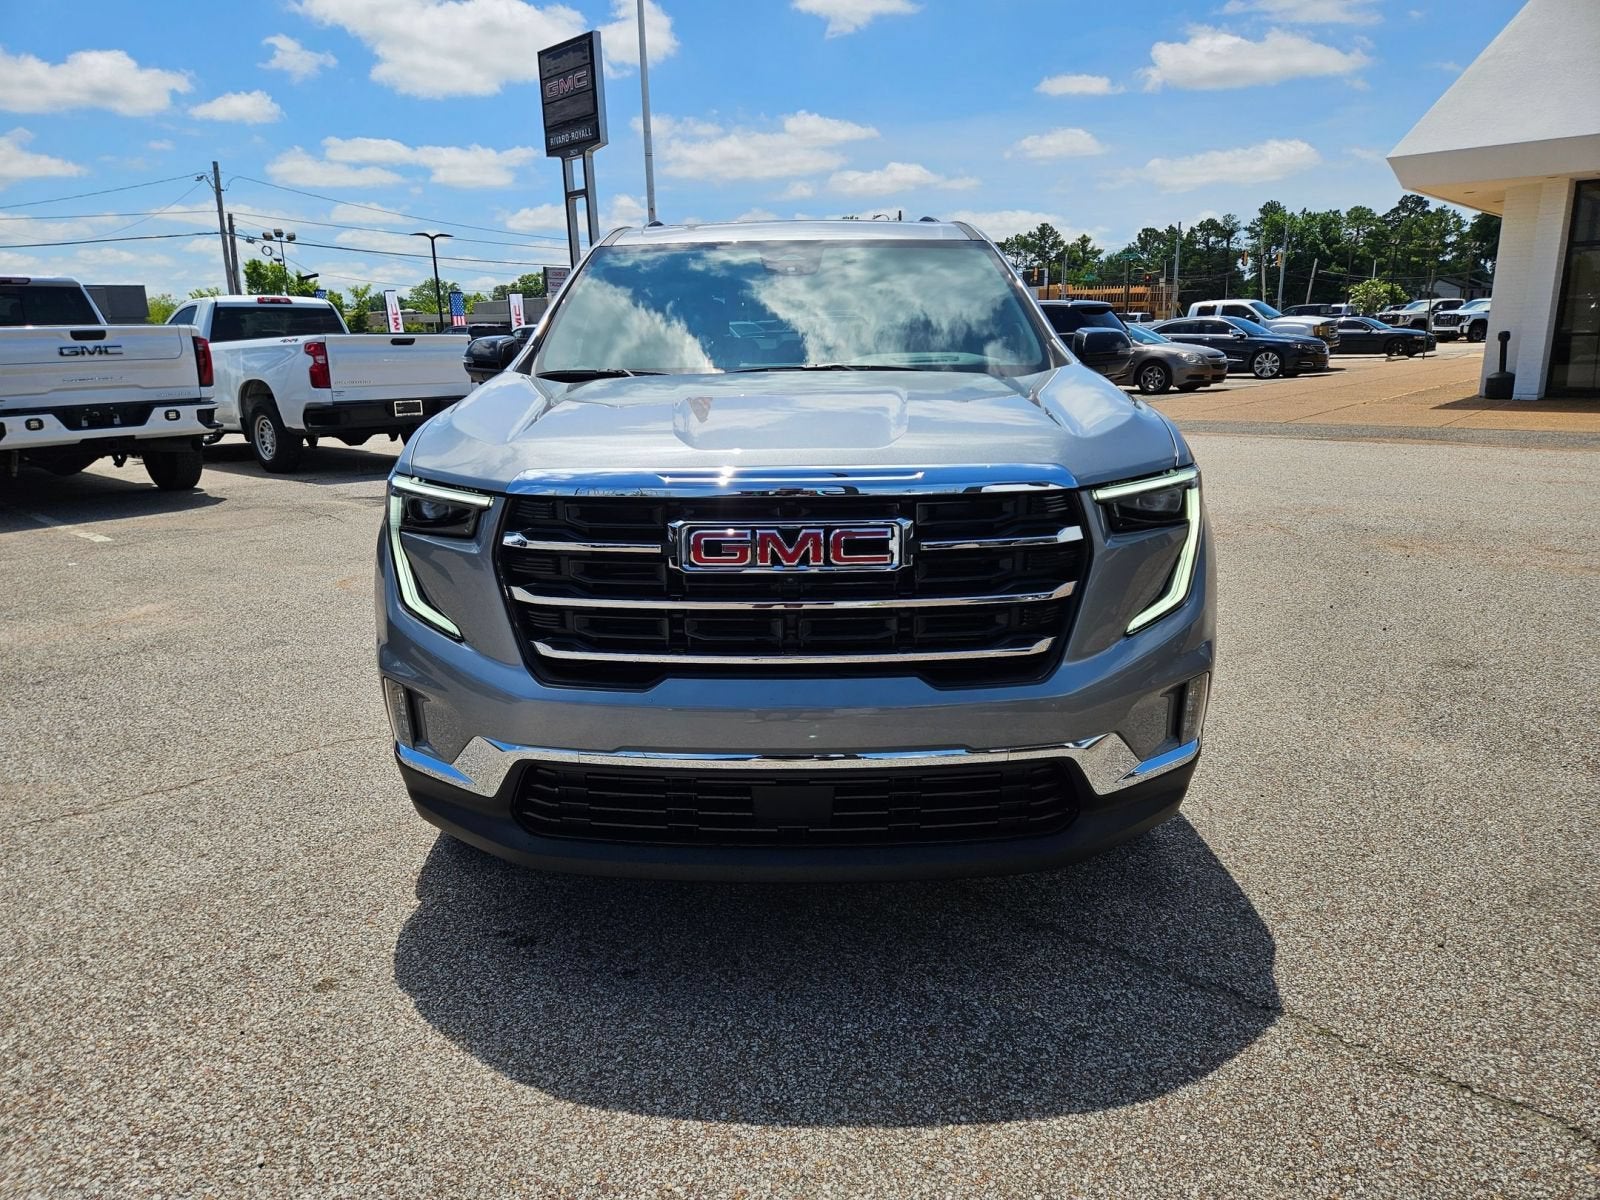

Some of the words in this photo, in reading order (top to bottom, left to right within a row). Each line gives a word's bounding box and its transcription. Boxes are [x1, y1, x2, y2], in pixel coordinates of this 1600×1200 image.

[545, 70, 588, 98] GMC
[390, 303, 401, 331] MC
[512, 304, 522, 327] MC
[57, 344, 124, 357] GMC
[689, 528, 892, 566] GMC
